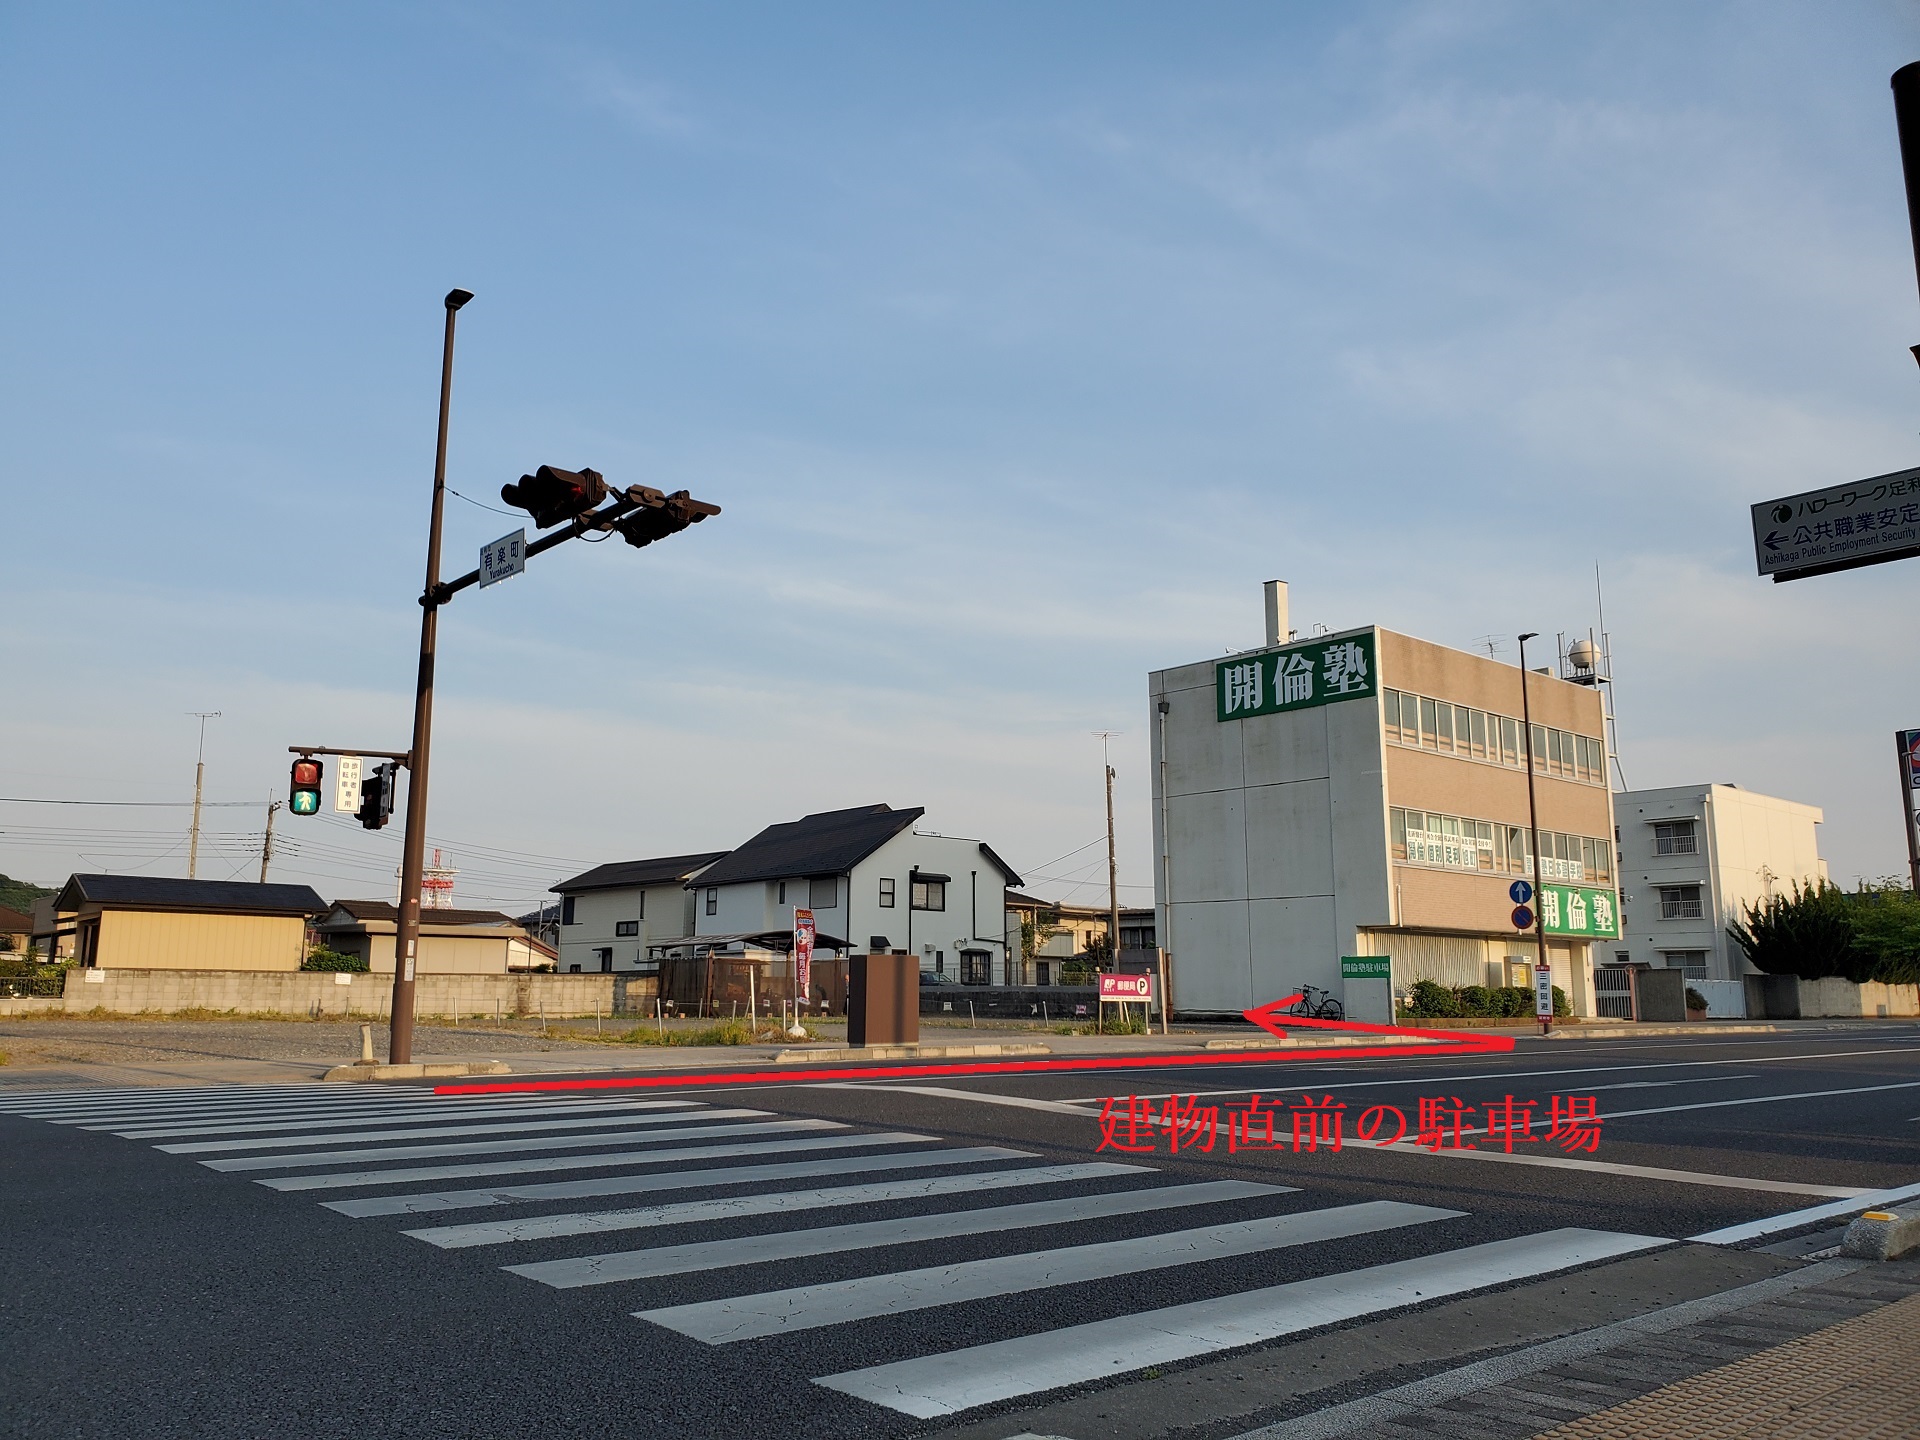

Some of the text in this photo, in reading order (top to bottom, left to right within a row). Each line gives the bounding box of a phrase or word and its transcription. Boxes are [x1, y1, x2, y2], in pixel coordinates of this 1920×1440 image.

[1793, 503, 1920, 545] 公共職業安定
[484, 540, 519, 571] 有楽町
[1765, 526, 1916, 565] Ashikaga Public Employment Security
[1224, 641, 1369, 715] 開倫塾
[1541, 889, 1614, 932] 開倫塾
